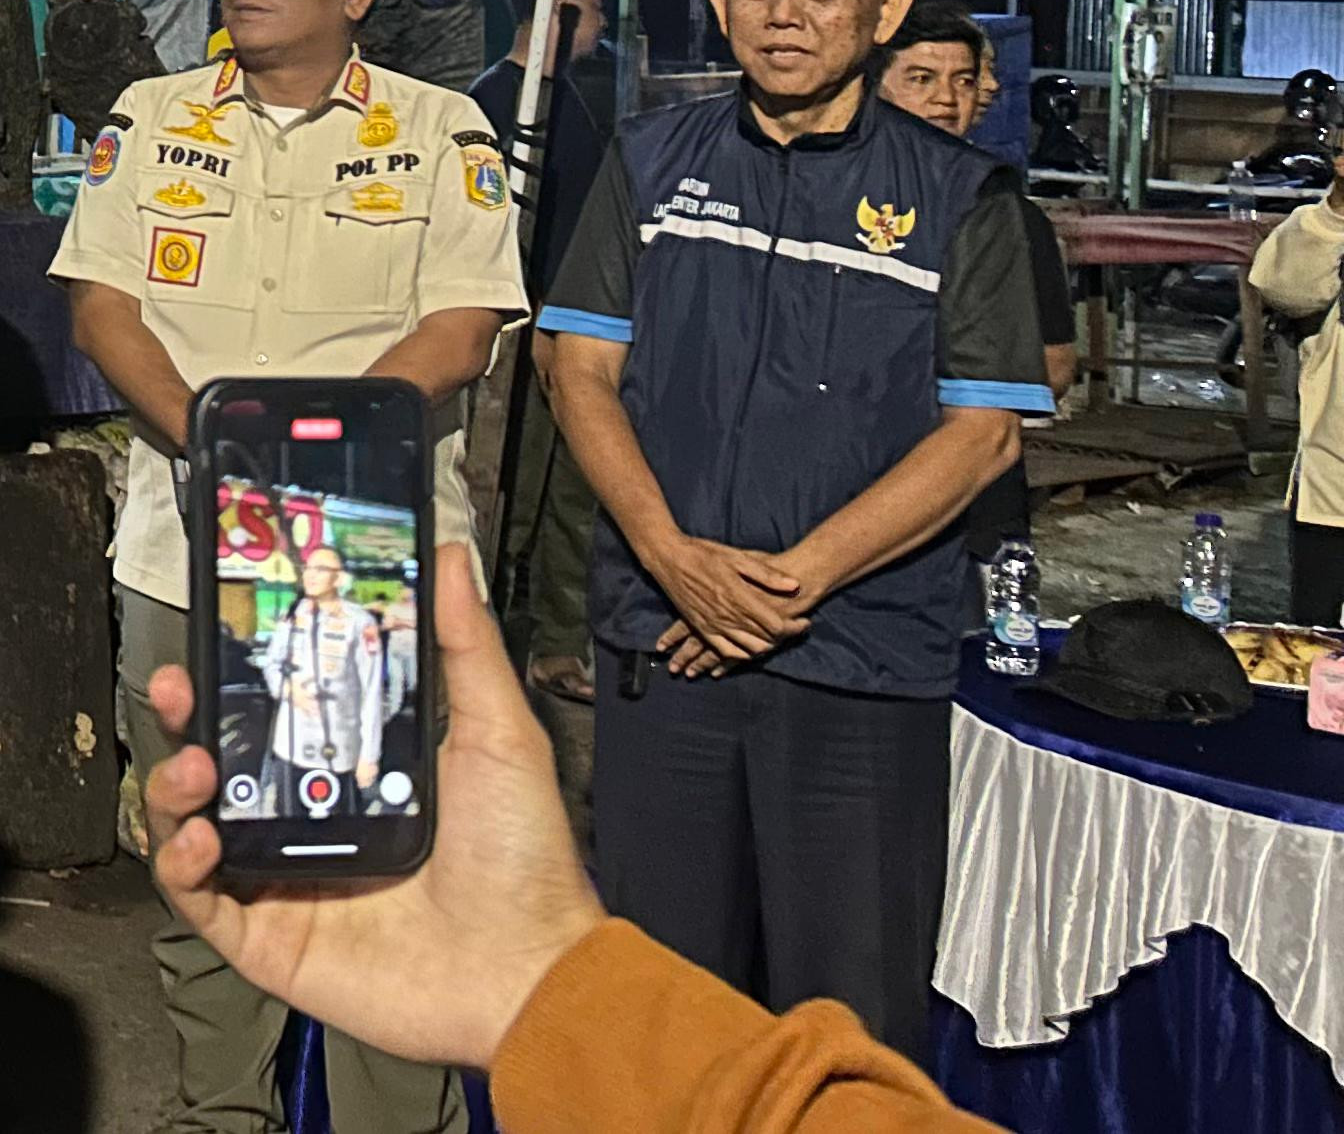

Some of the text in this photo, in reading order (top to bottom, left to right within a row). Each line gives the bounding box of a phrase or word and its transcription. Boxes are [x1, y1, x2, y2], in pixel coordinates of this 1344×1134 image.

[155, 143, 231, 178] YOPRI
[335, 152, 420, 182] POL PP
